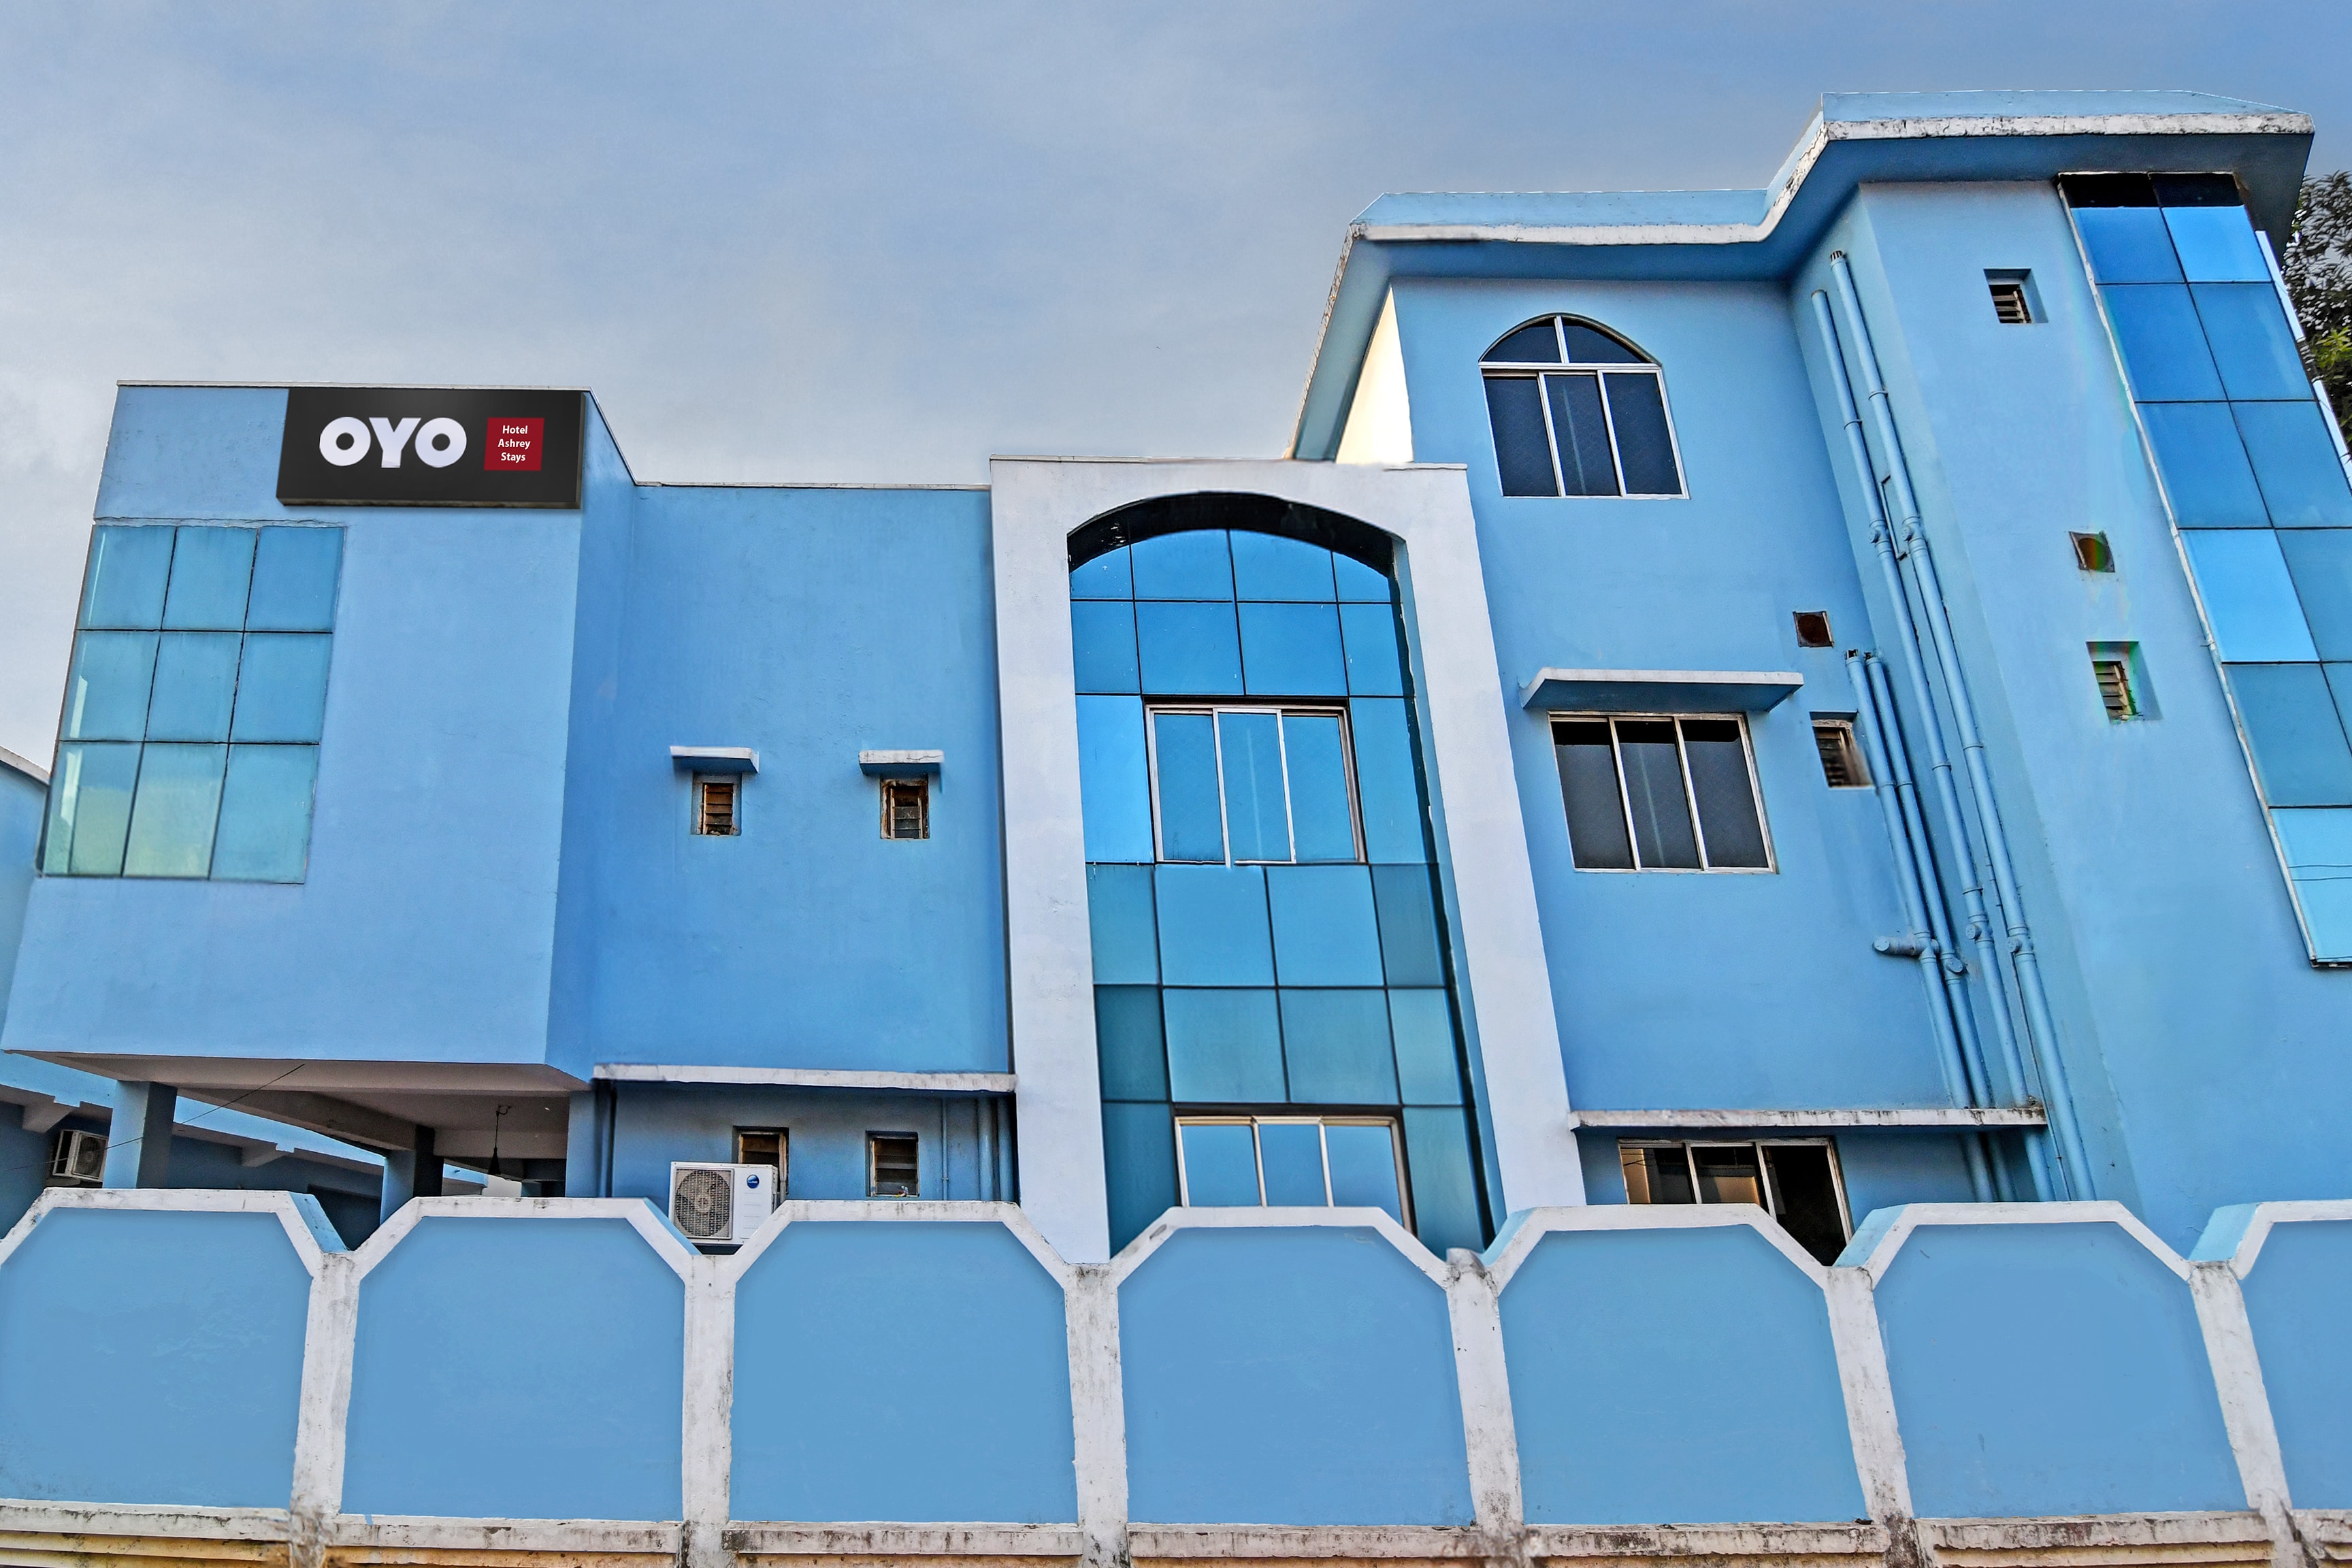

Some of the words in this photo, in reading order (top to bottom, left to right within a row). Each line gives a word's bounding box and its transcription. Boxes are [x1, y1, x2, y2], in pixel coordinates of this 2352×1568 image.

[502, 425, 528, 434] Hotel
[319, 416, 468, 468] OYO
[497, 438, 531, 450] Ashrey
[501, 452, 526, 463] Stays
